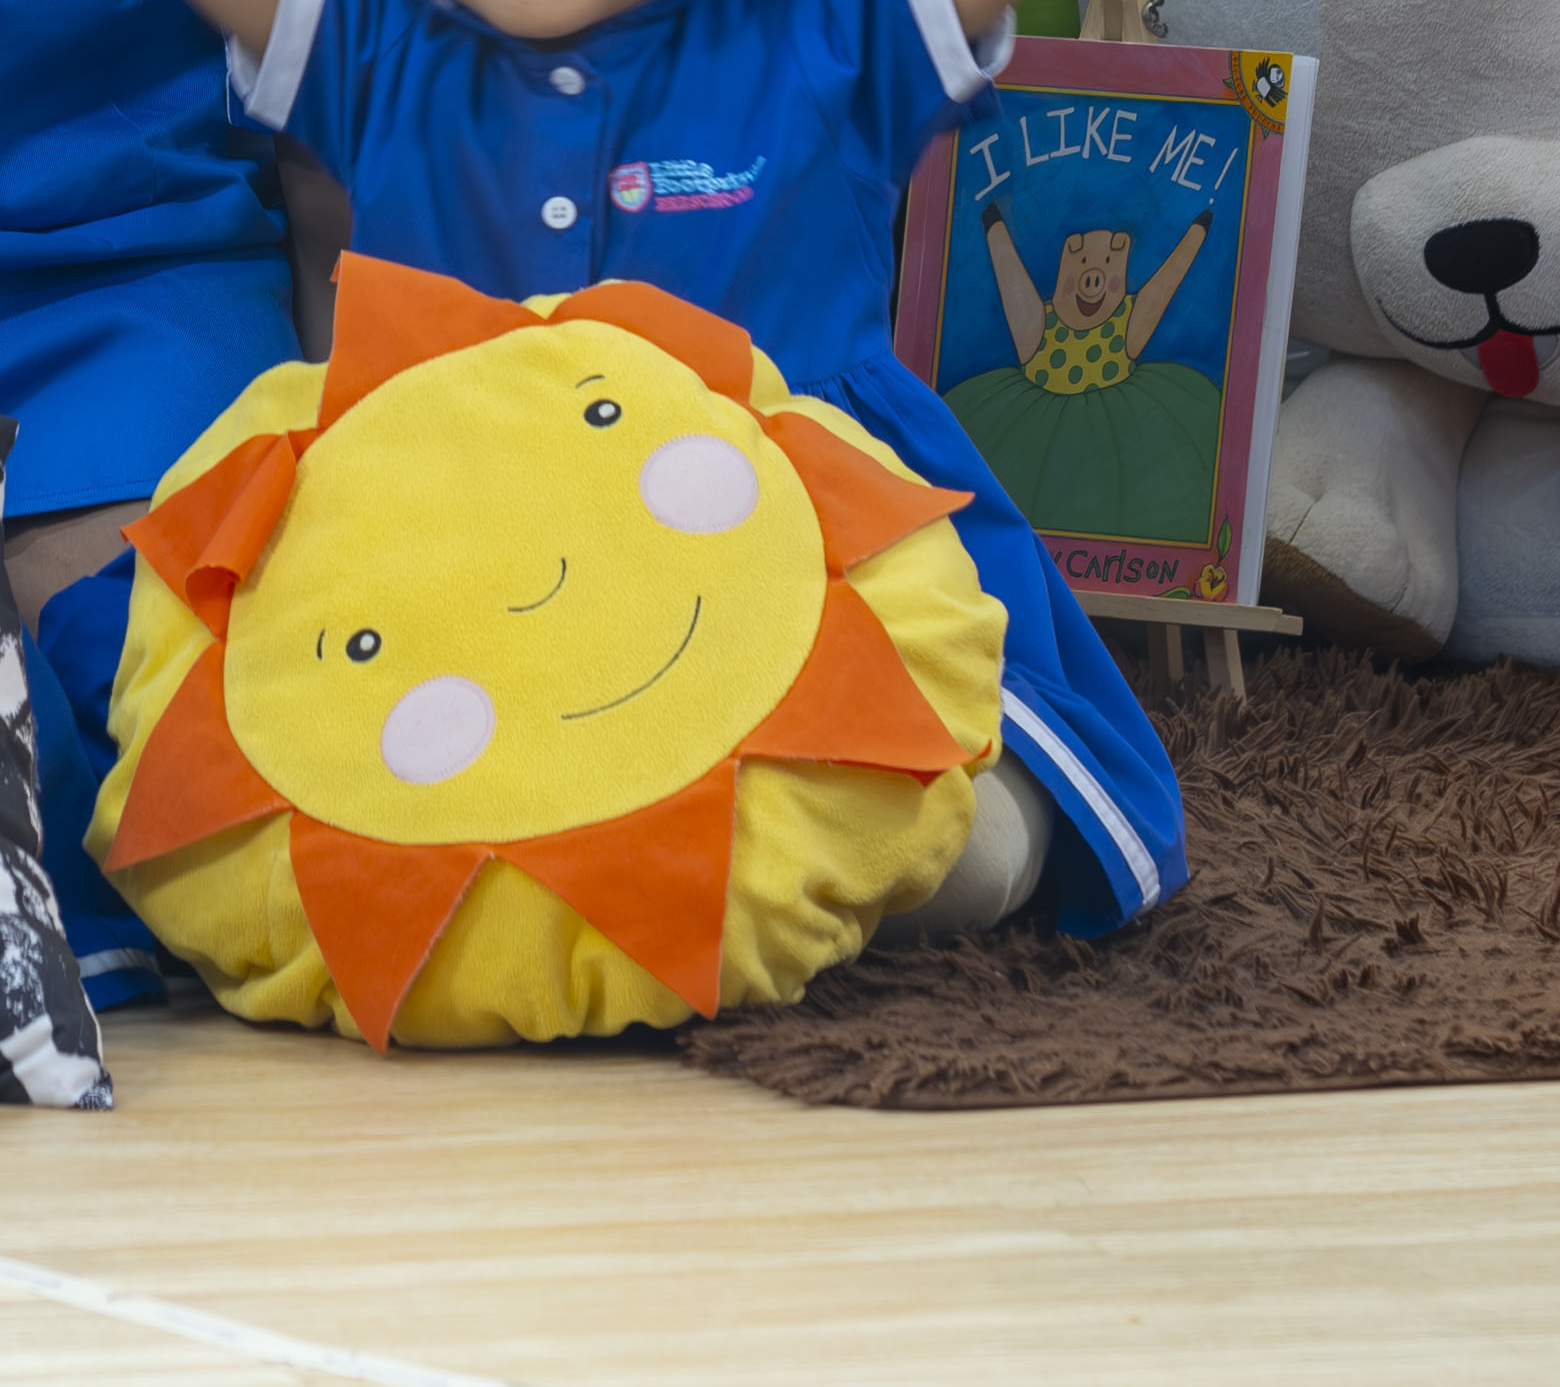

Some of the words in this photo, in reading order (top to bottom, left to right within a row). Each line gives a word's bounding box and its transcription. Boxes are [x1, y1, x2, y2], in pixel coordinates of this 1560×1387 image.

[970, 131, 1011, 201] I
[1021, 106, 1137, 167] LIKE
[1149, 125, 1238, 205] ME!
